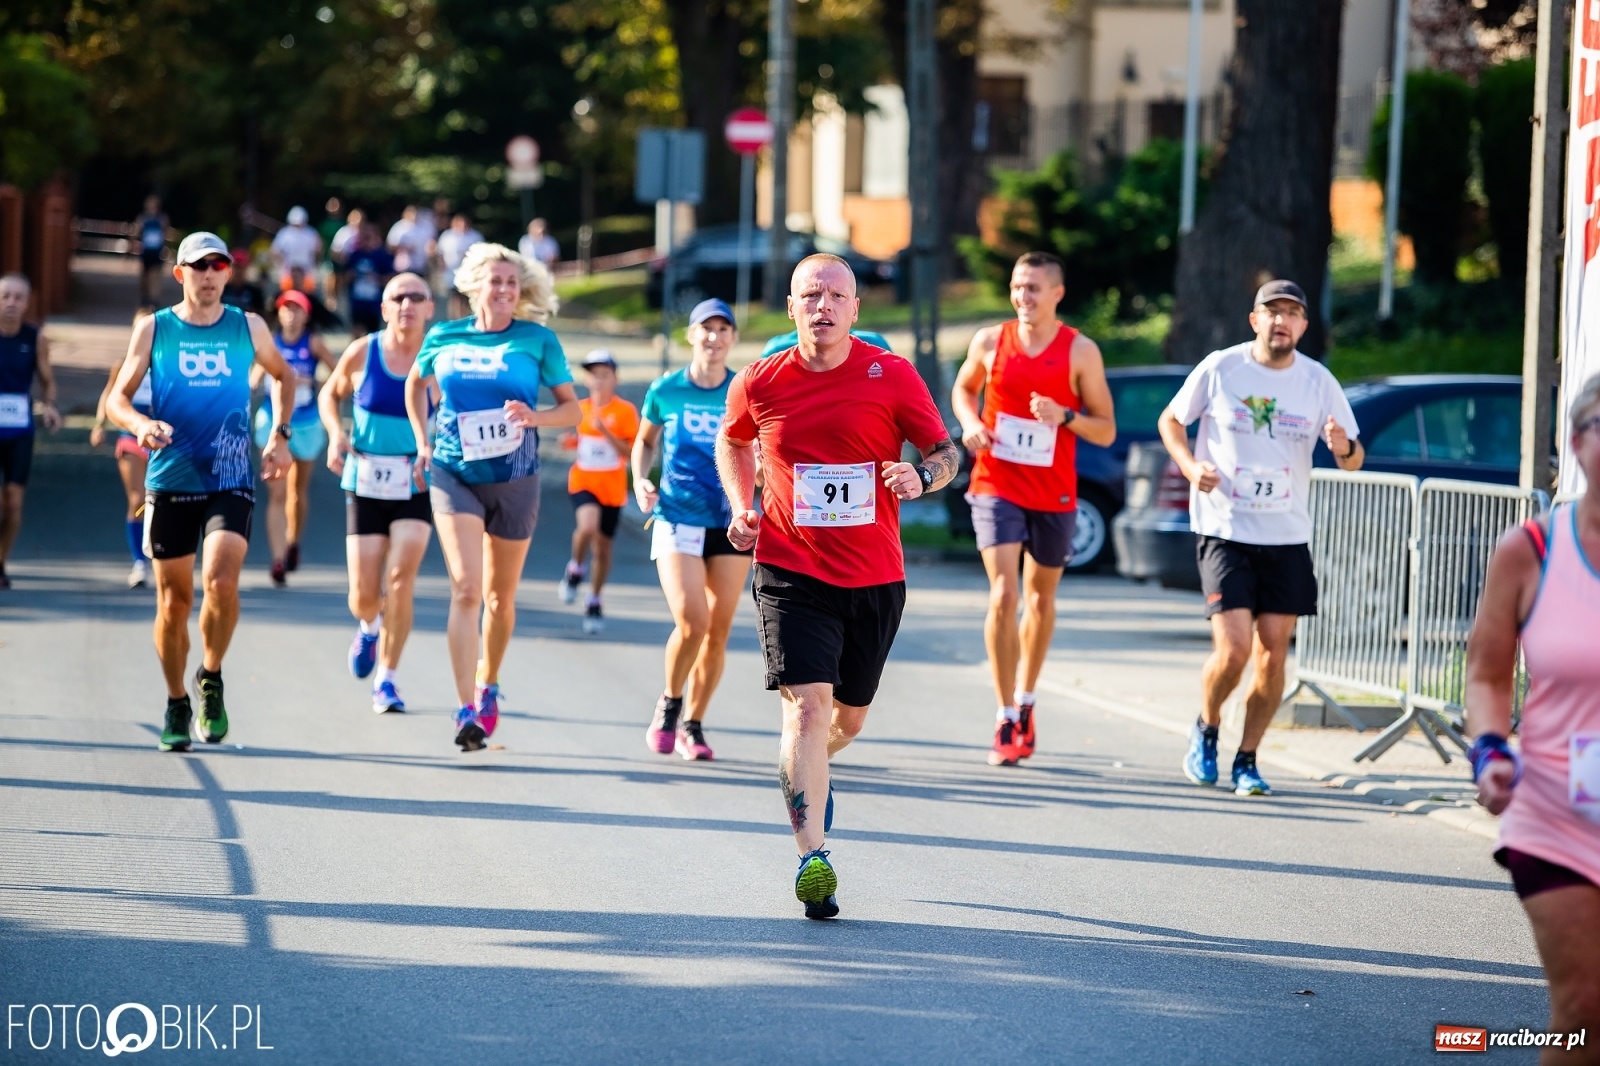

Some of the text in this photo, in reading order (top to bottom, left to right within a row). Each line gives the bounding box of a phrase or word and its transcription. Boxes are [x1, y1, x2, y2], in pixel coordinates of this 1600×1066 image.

[179, 350, 231, 378] bbl
[479, 423, 507, 440] 118
[1018, 433, 1033, 447] 11
[375, 469, 391, 484] 97
[823, 482, 849, 505] 91
[1255, 482, 1273, 496] 73
